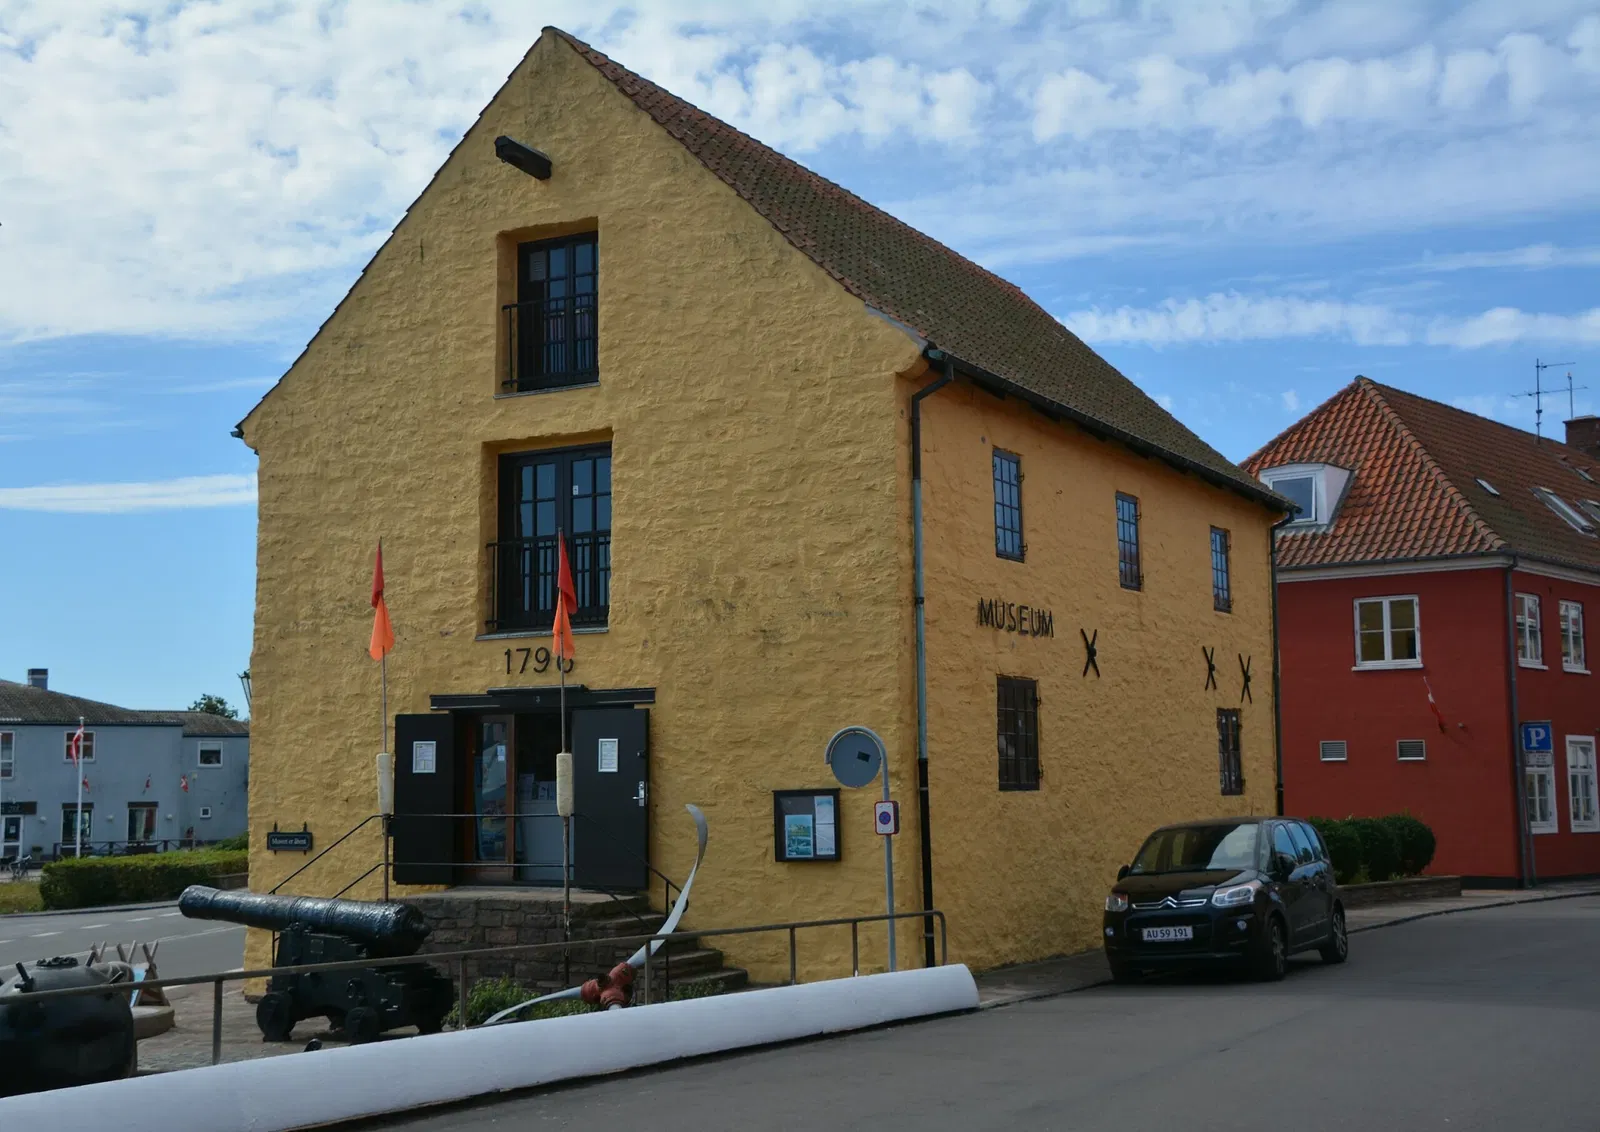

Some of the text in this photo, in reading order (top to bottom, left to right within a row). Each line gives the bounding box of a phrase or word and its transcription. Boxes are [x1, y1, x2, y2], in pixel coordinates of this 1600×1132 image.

[976, 597, 1054, 638] MUSEUM
[1527, 727, 1546, 748] P
[1146, 928, 1188, 939] AU 59 191
